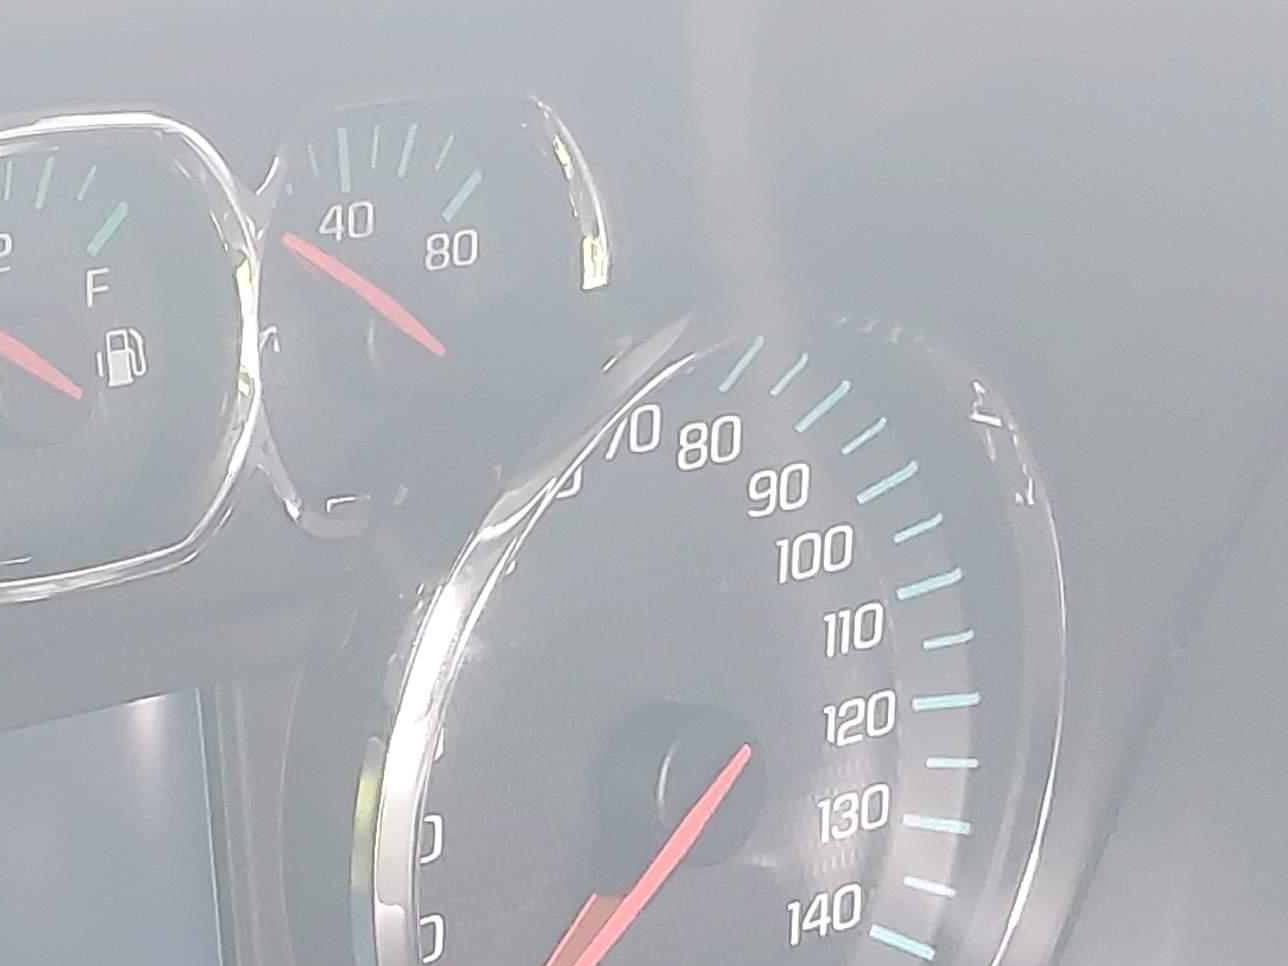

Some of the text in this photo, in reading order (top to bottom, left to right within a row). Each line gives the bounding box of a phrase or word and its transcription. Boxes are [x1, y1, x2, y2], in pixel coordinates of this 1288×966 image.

[319, 200, 374, 242] 40
[425, 229, 478, 271] 80
[85, 267, 110, 308] F
[677, 415, 741, 470] 80
[747, 463, 810, 517] 90
[776, 525, 853, 584] 100
[823, 603, 884, 658] 110
[823, 690, 896, 747] 120
[817, 784, 889, 844] 130
[787, 884, 861, 946] 140
